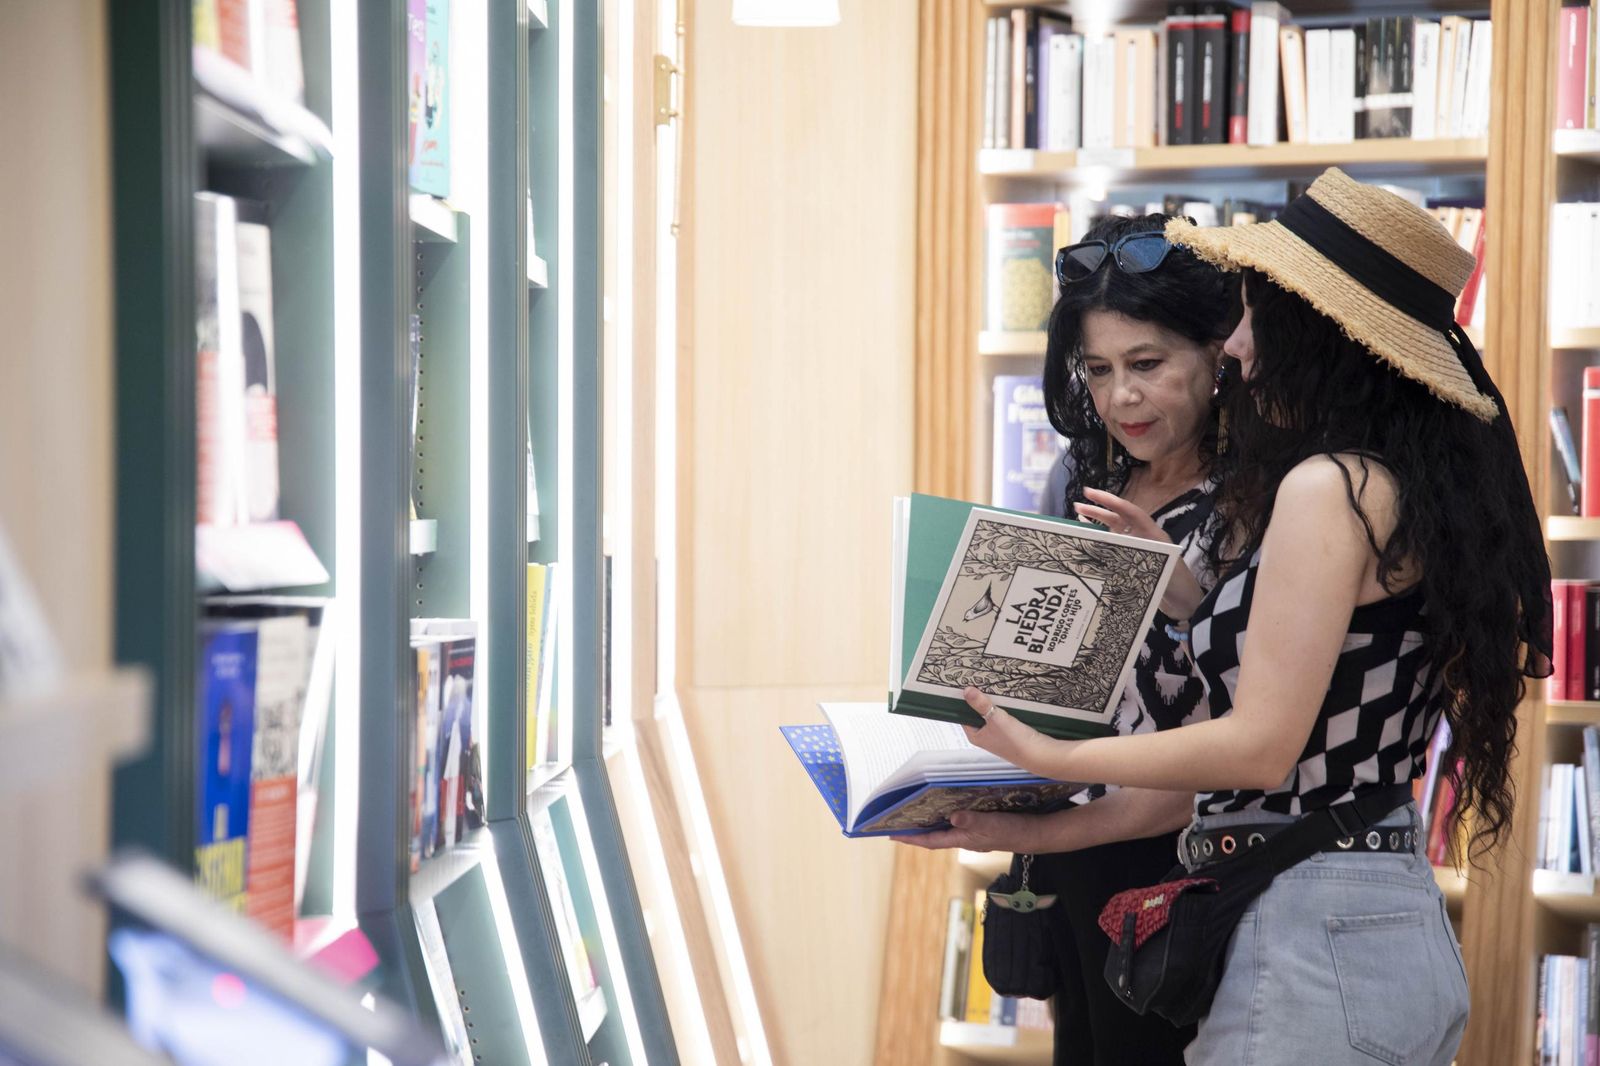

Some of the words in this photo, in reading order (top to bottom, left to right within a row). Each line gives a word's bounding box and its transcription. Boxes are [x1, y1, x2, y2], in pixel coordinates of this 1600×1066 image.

[1006, 602, 1027, 624] LA
[1013, 586, 1051, 645] PIEDRA
[1028, 584, 1069, 653] BLANDA
[1070, 599, 1082, 616] HIJO
[1047, 619, 1065, 652] RODRIGO
